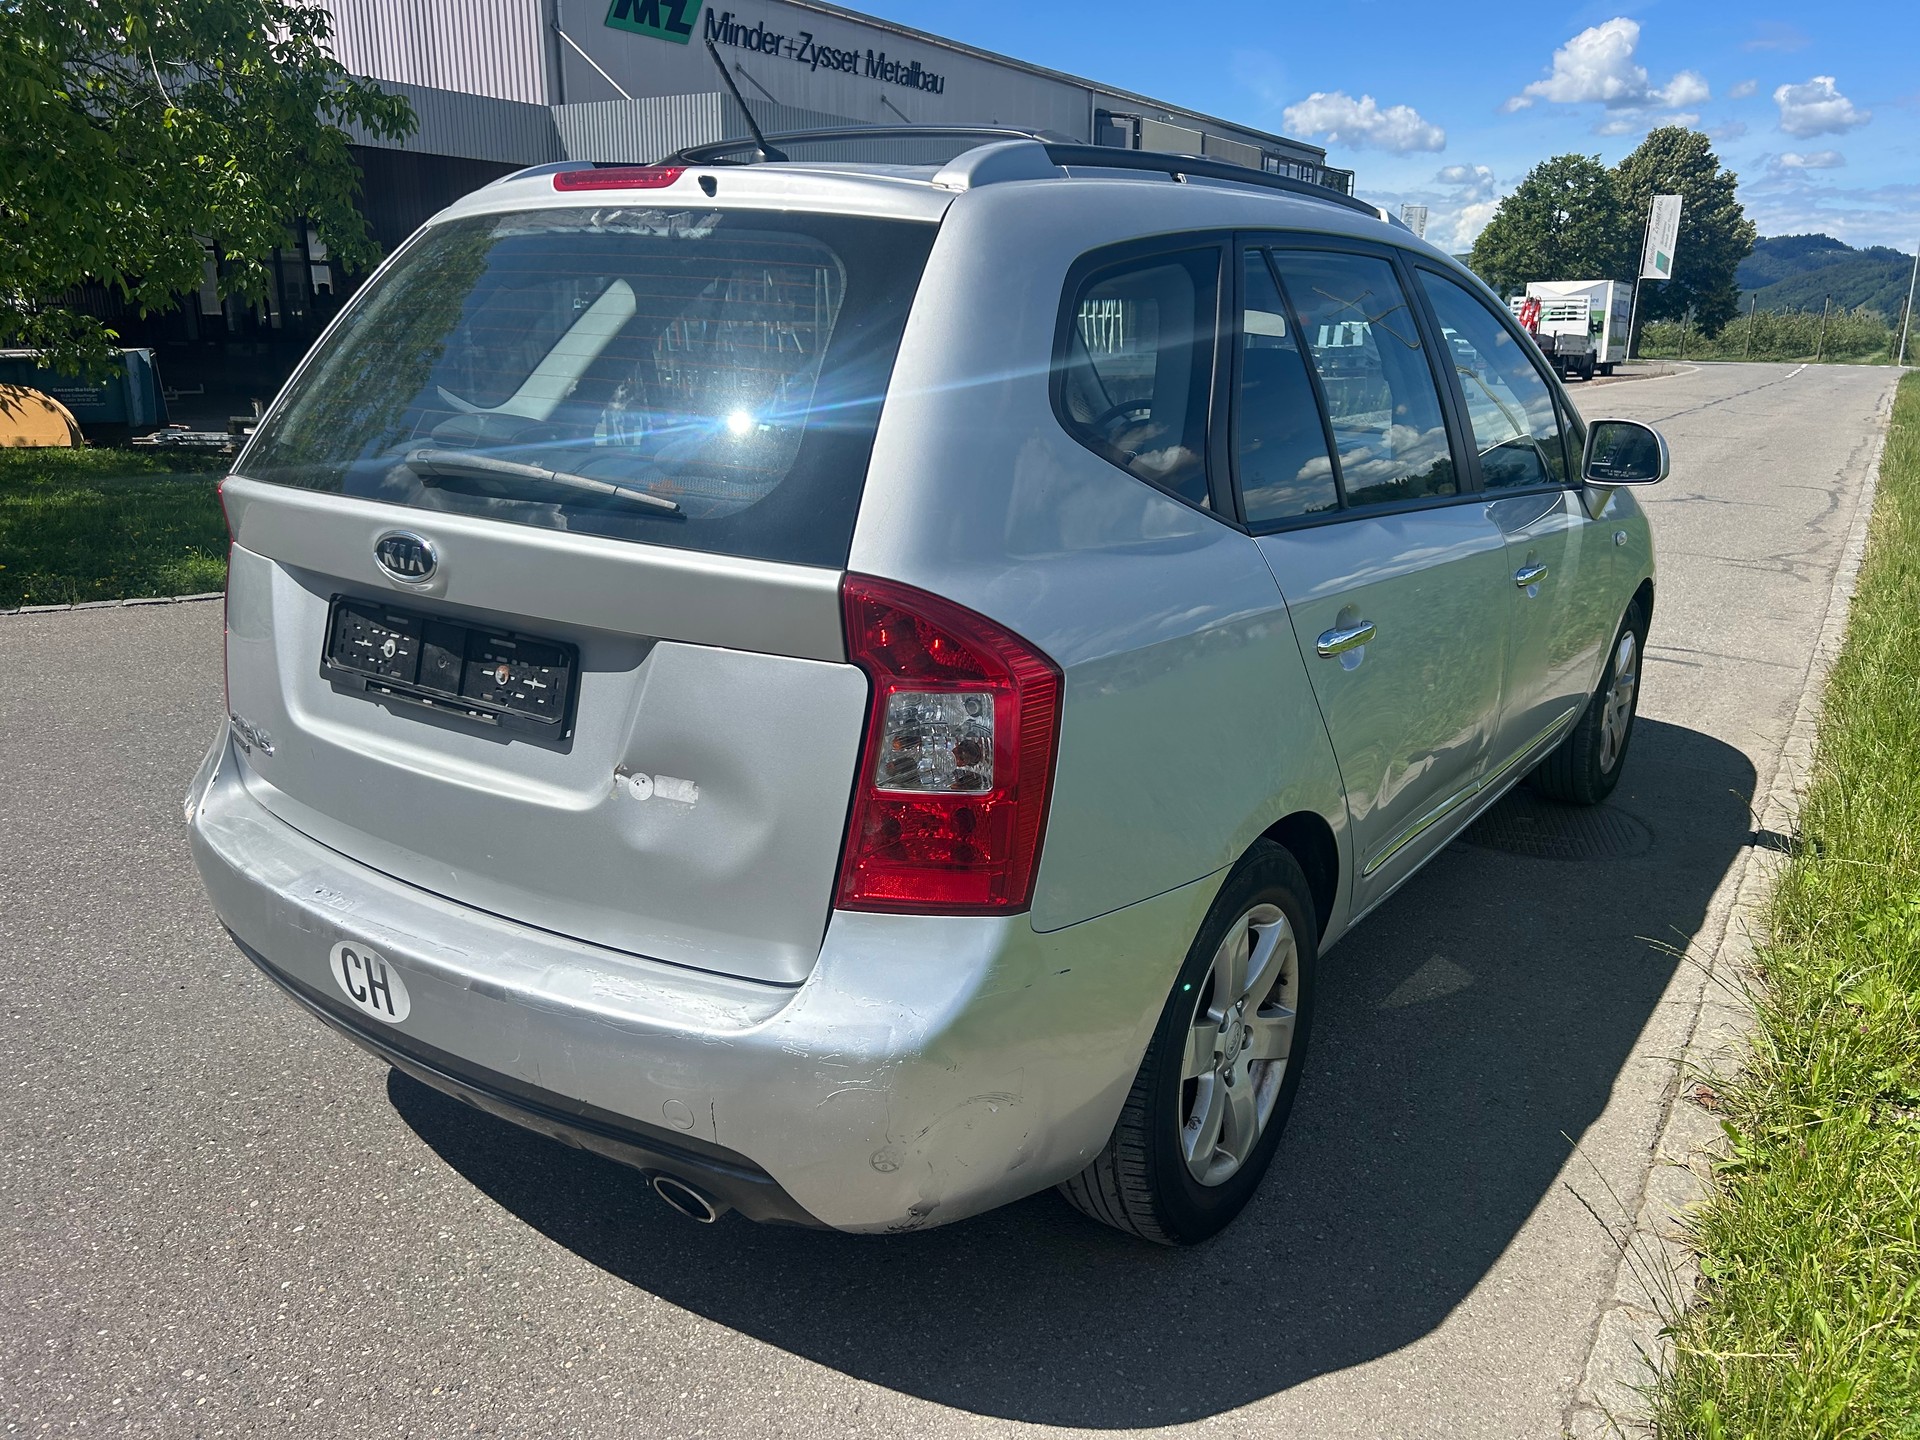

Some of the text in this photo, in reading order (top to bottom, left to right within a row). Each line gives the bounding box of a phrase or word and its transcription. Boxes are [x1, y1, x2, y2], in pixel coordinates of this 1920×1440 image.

[613, 0, 691, 42] MZ
[864, 48, 945, 95] Metallbau
[383, 540, 426, 573] KIA
[341, 947, 395, 1017] CH
